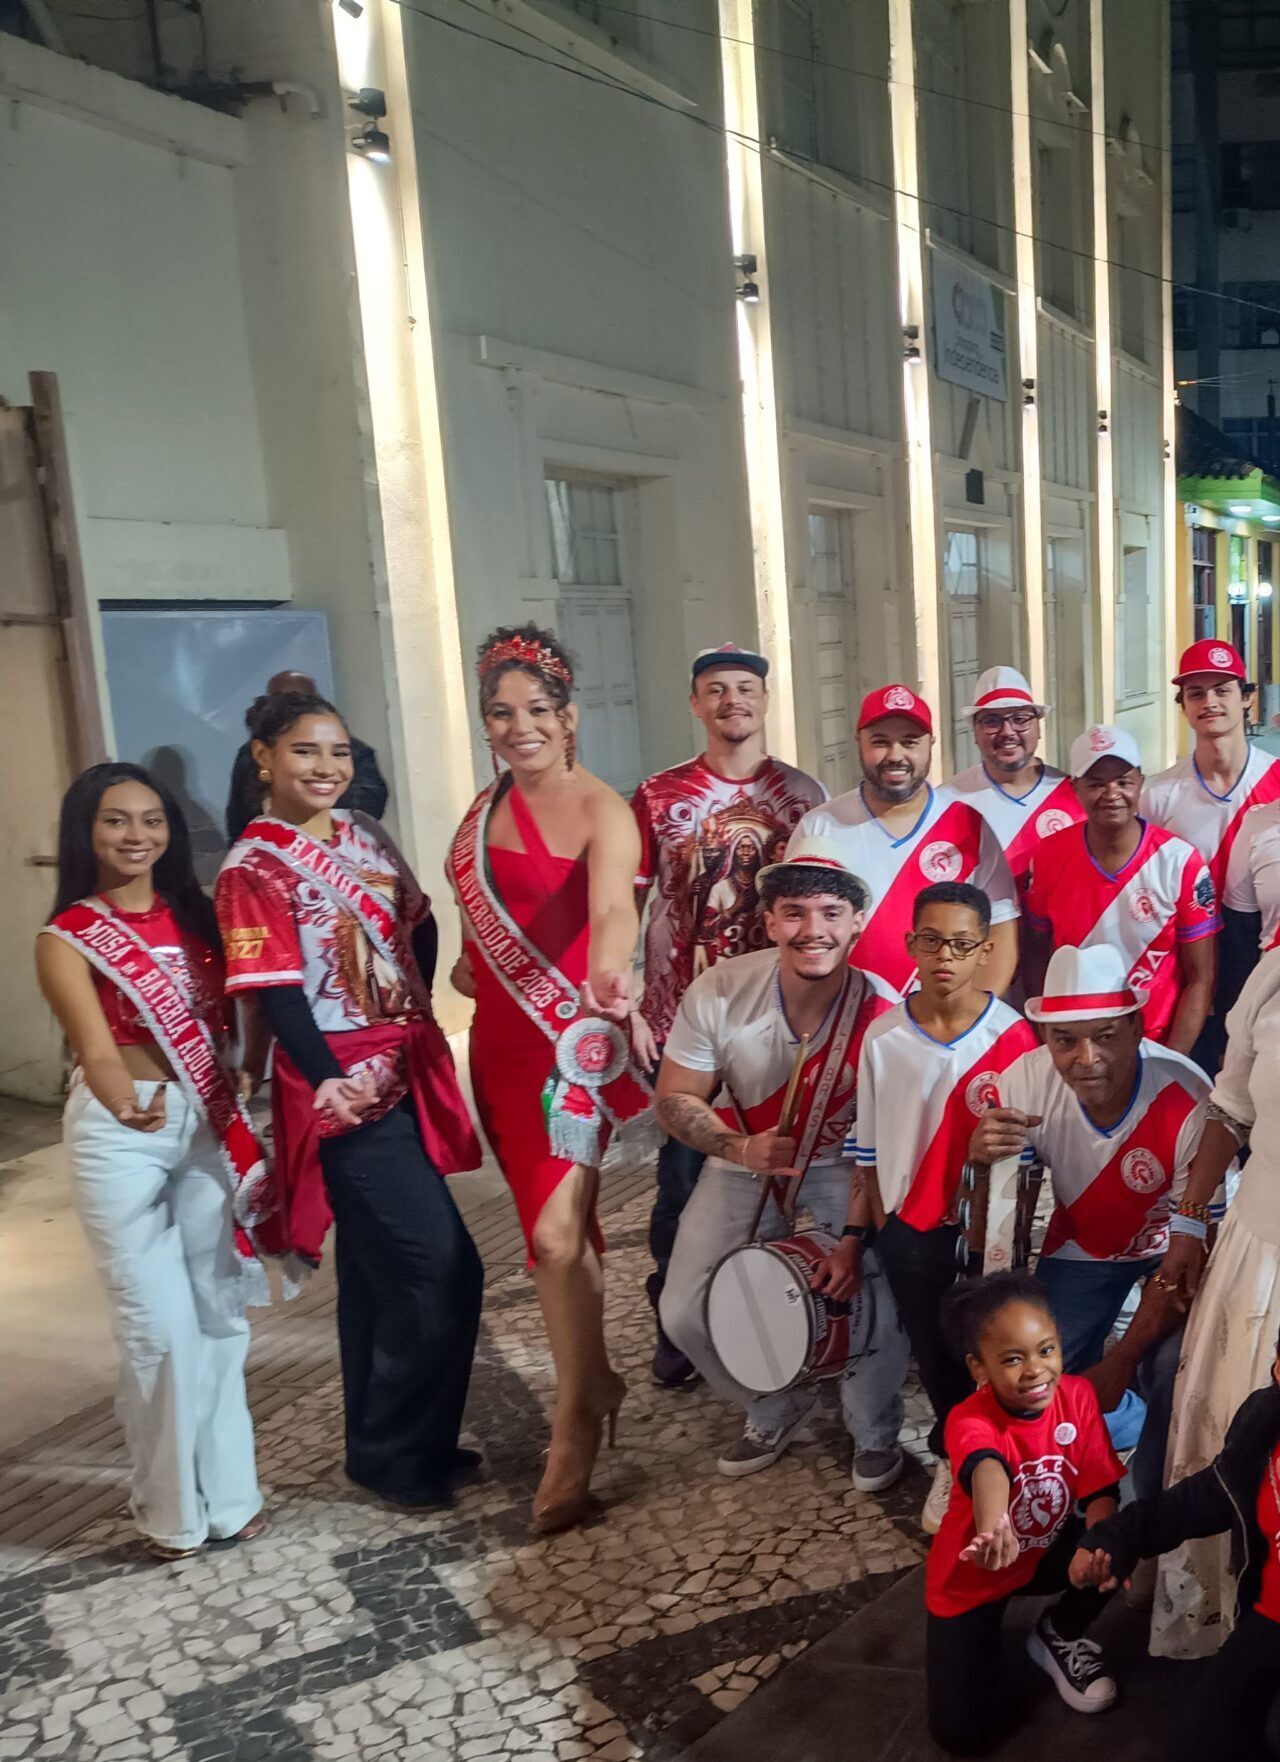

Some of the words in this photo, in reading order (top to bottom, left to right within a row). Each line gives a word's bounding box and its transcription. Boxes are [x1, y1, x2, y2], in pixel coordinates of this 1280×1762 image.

[75, 918, 135, 963] MUSA
[133, 967, 196, 1040] BATERIA
[458, 867, 530, 975] DIVERSIDADE
[515, 967, 561, 1009] 2026
